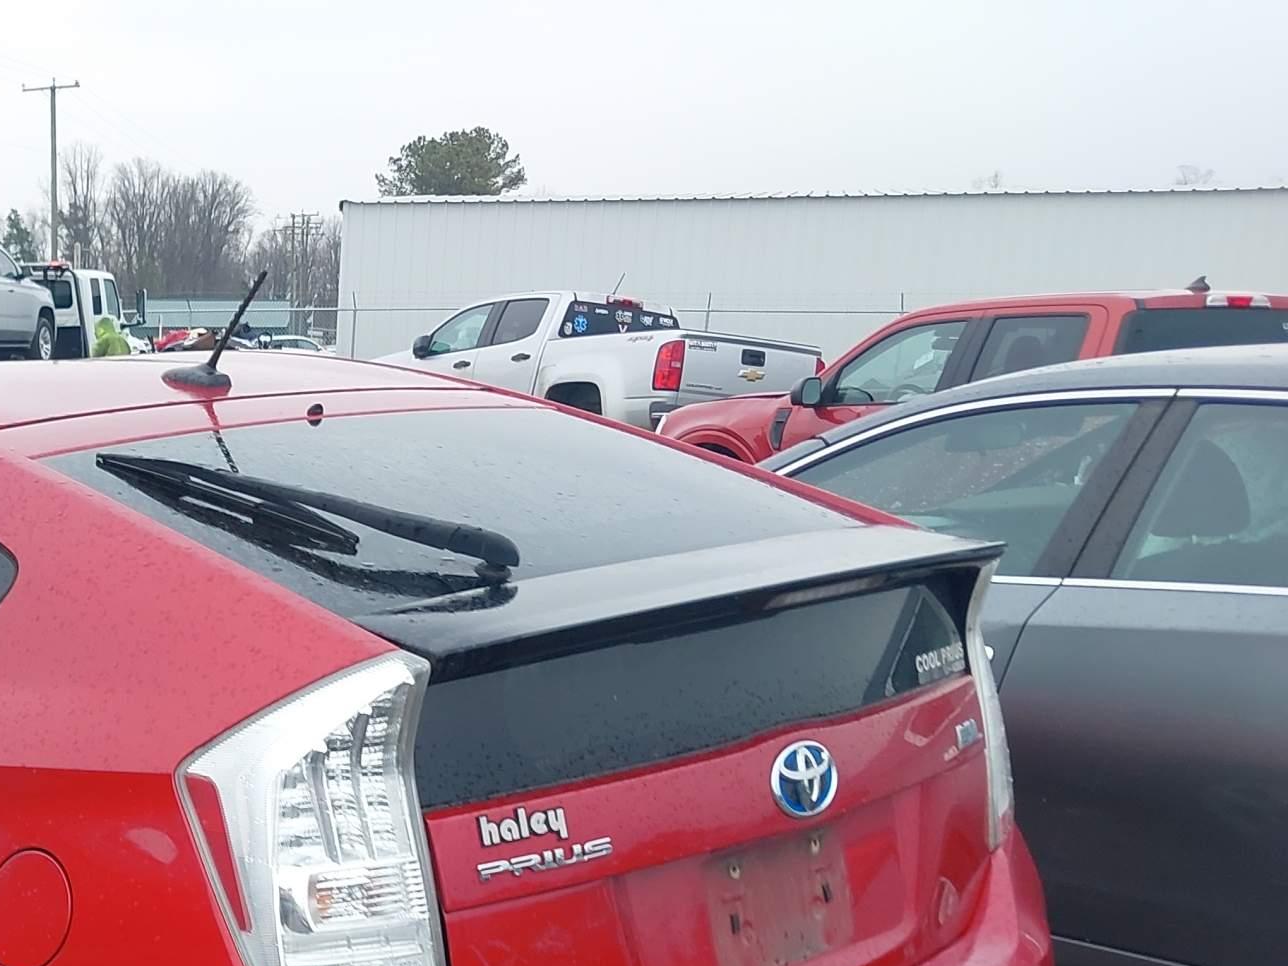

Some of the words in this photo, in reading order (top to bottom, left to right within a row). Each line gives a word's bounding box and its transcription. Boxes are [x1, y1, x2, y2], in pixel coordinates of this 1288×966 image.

[915, 650, 941, 673] COOL
[478, 806, 569, 847] haley
[477, 837, 613, 880] PRIUS
